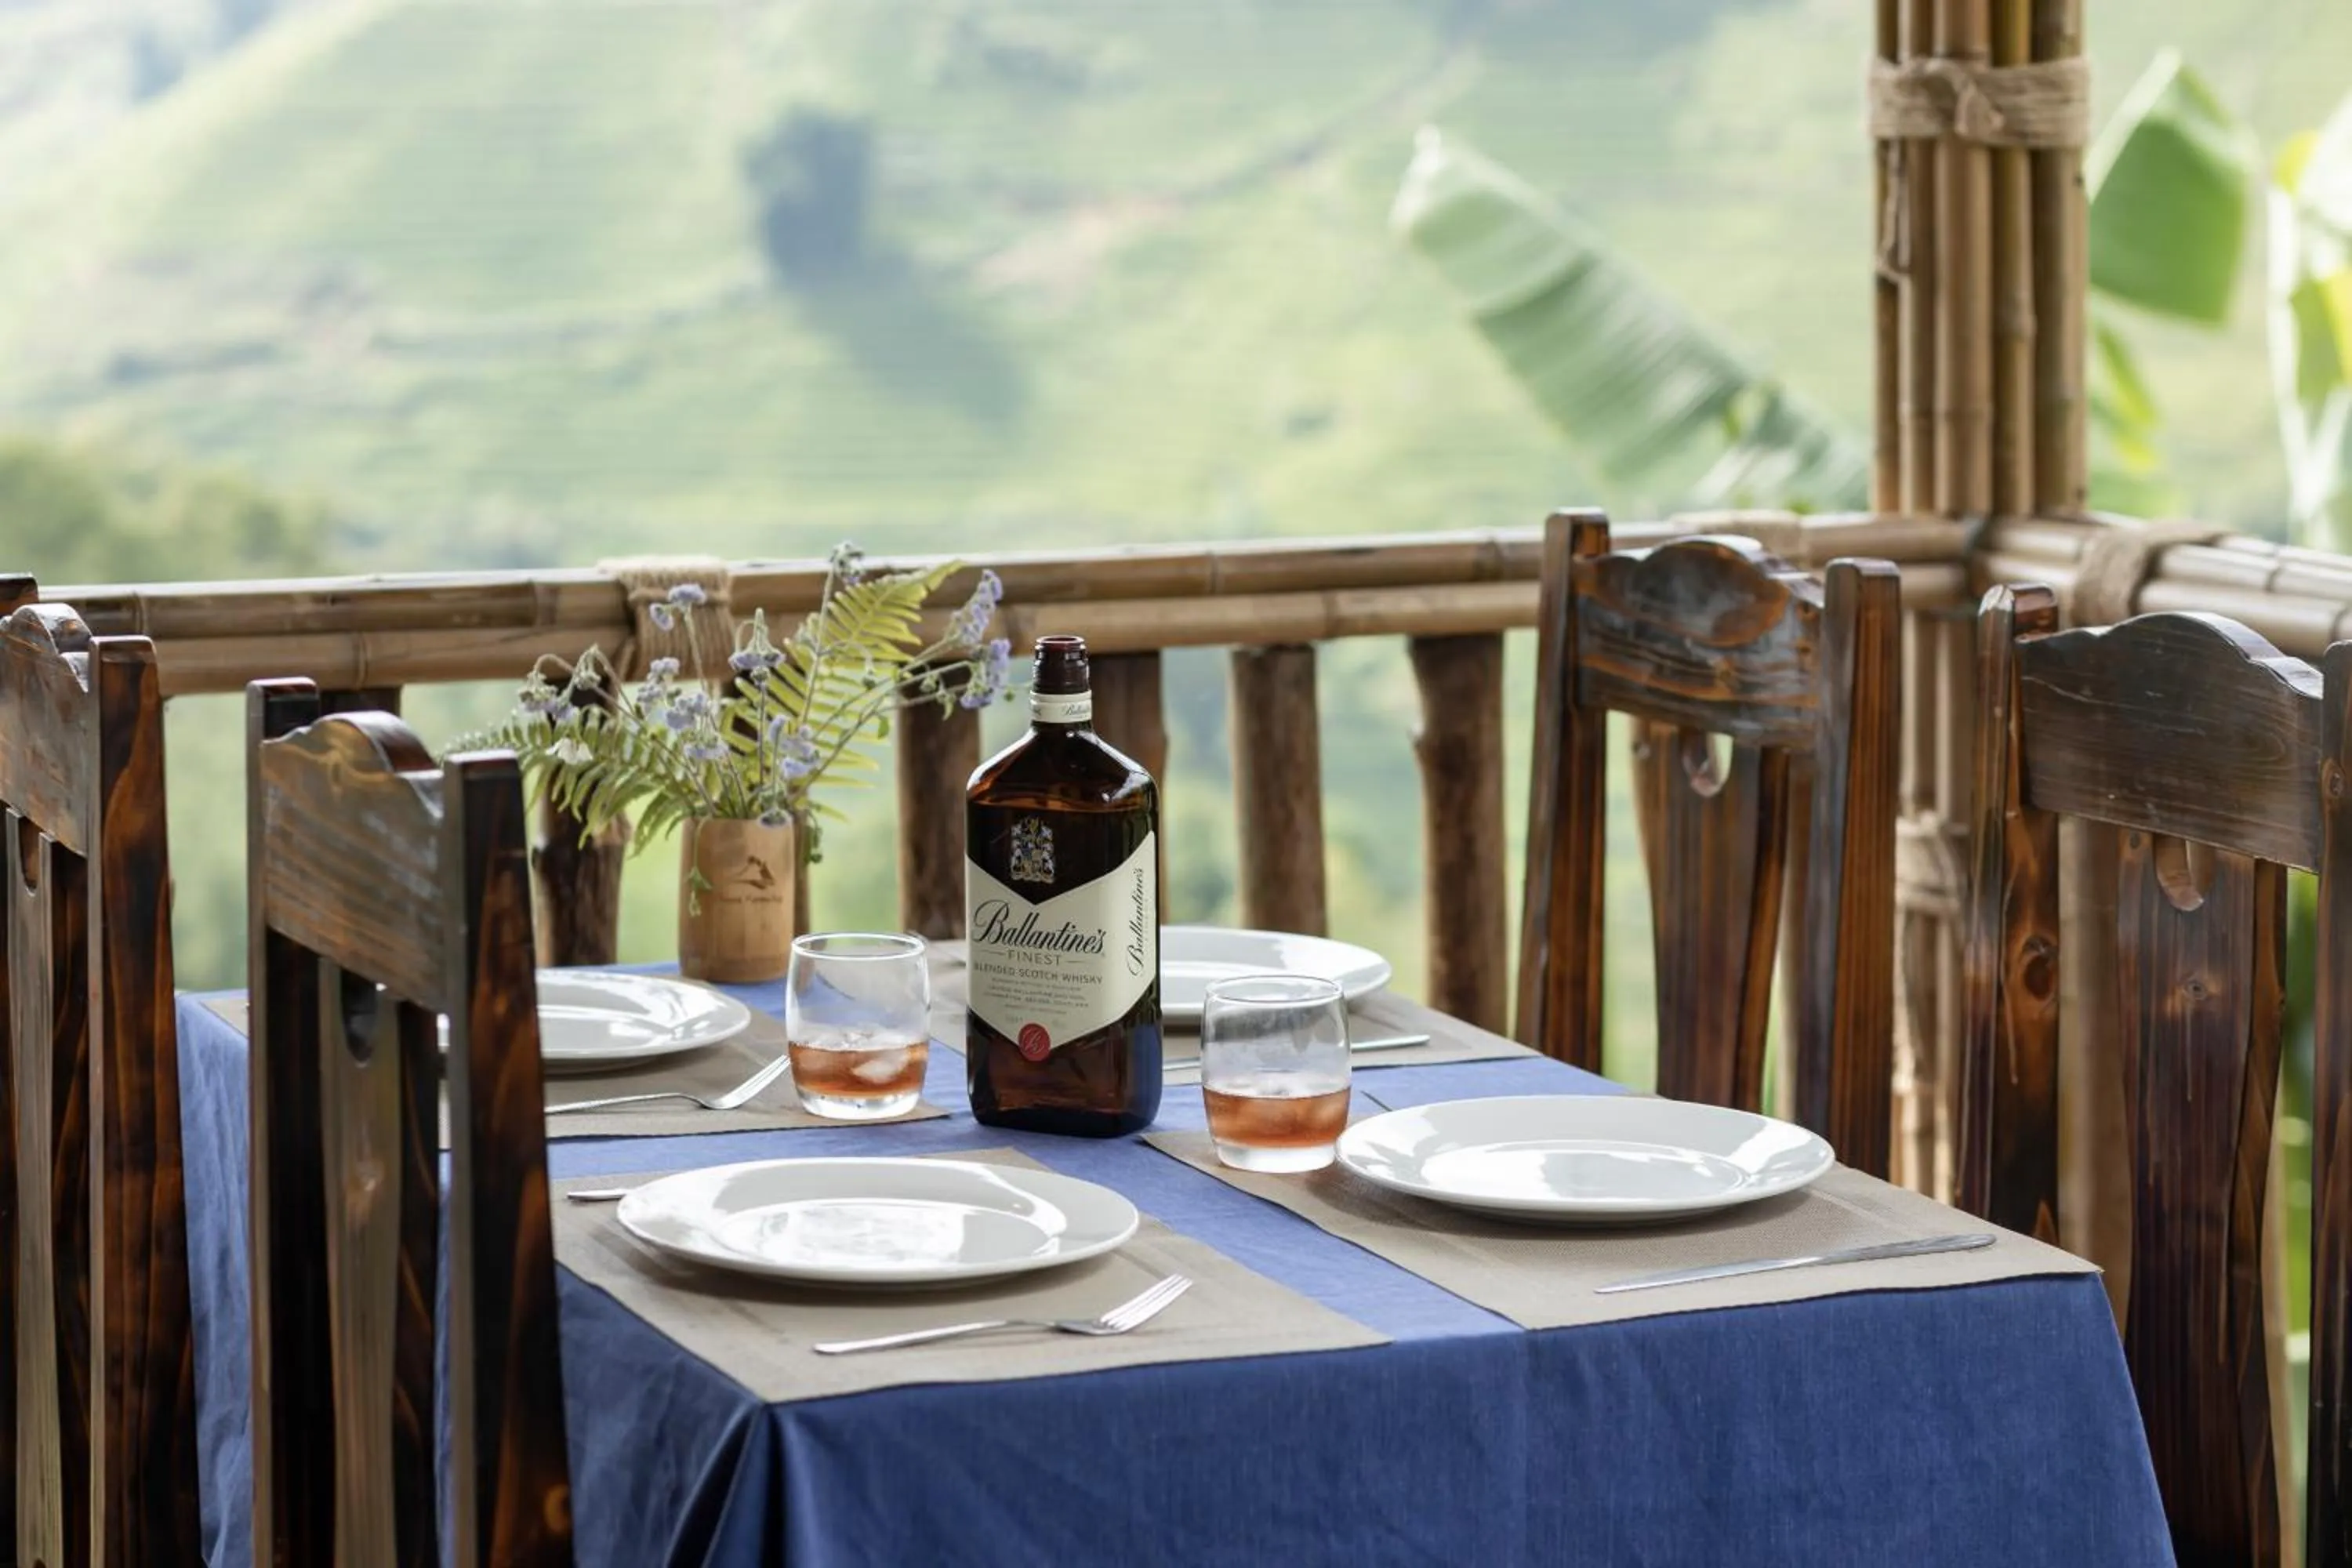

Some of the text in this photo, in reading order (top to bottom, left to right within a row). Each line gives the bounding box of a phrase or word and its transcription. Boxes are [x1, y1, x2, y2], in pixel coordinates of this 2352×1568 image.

[972, 899, 1107, 954] Ballantine's
[1127, 868, 1144, 977] Ballantine's
[974, 962, 1015, 977] BLENDED
[1018, 968, 1058, 981] SCOTCH
[1062, 973, 1103, 985] WHISKY
[1006, 949, 1062, 966] FINEST
